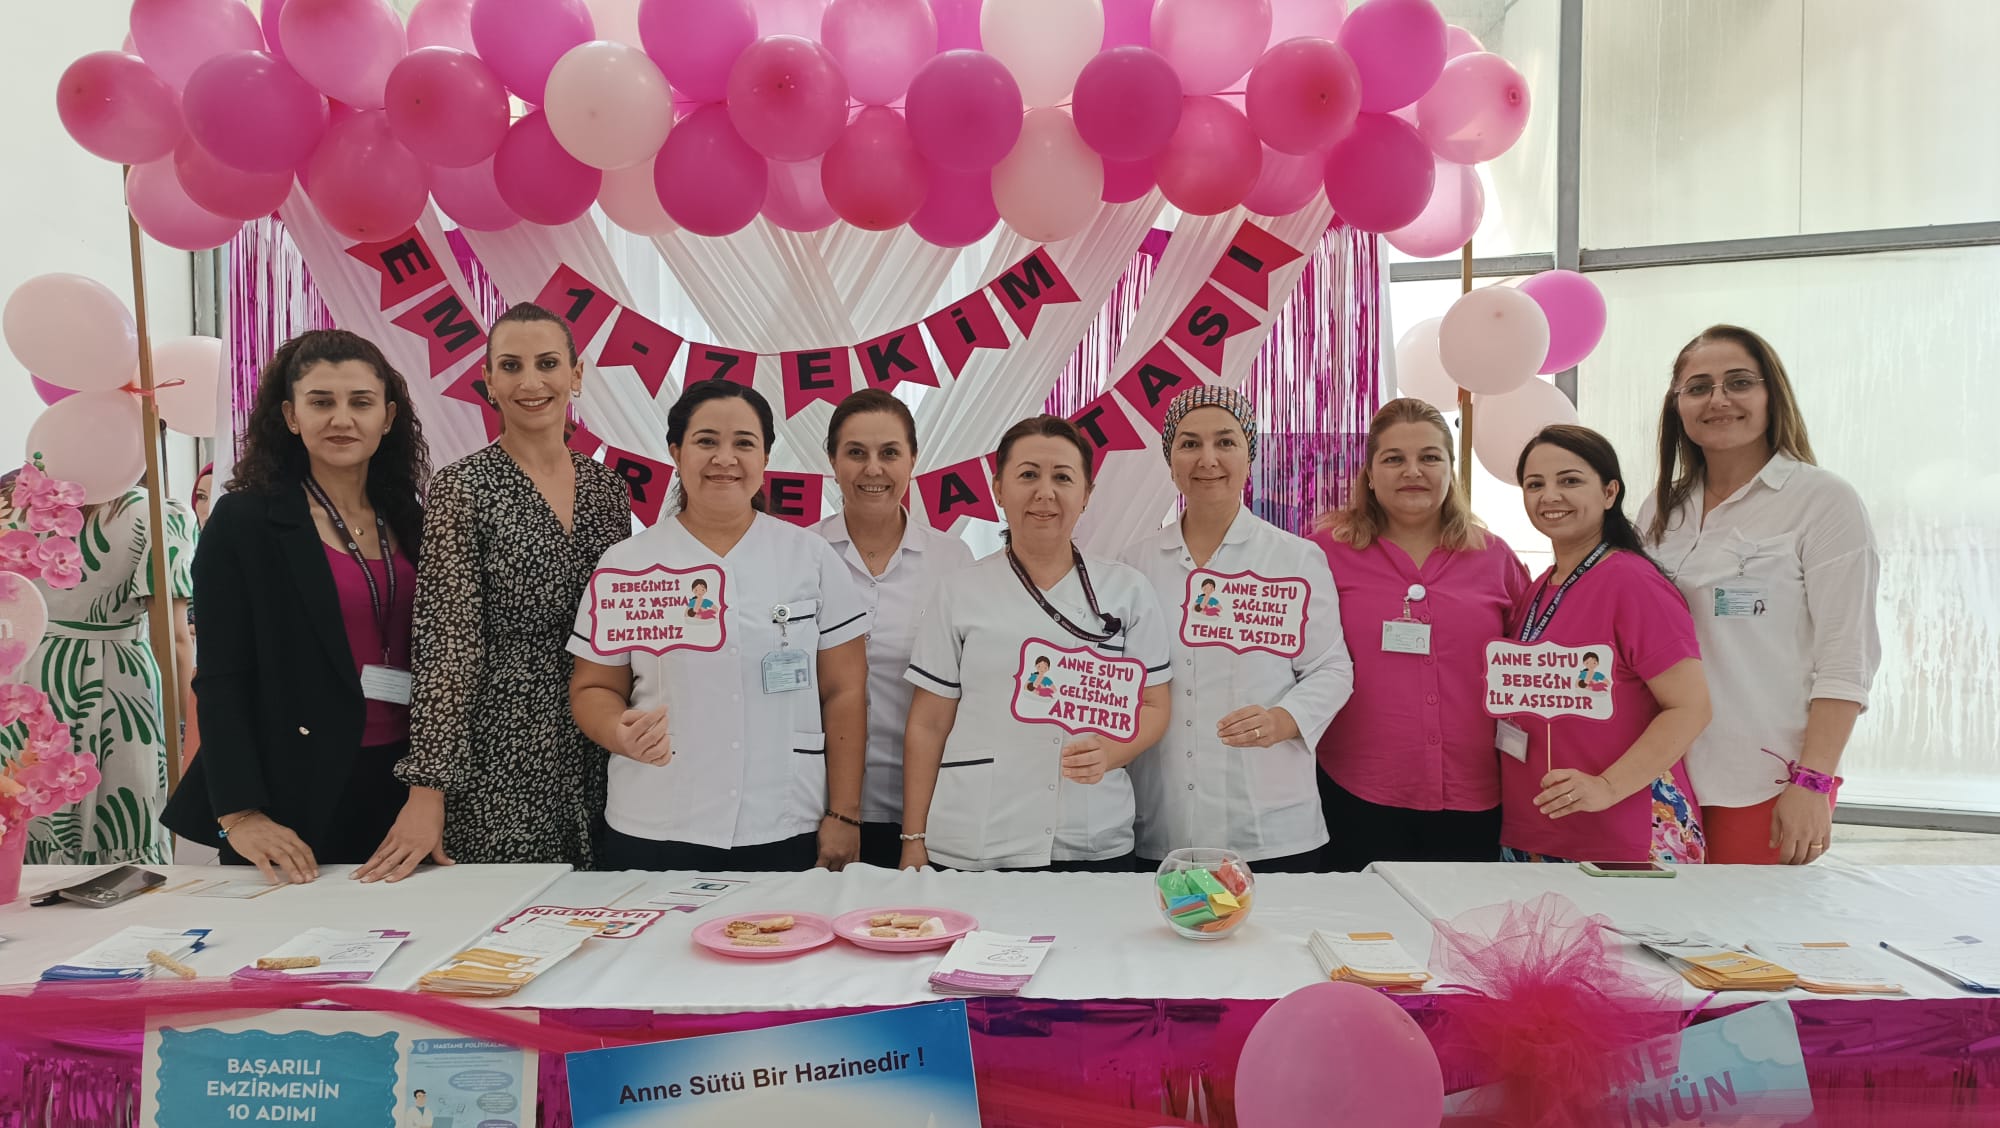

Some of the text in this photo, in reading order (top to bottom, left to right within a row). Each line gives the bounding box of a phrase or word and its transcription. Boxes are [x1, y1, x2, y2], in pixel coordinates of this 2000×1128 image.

[612, 579, 680, 593] BEBEĞİNİZİ
[1221, 581, 1257, 597] ANNE
[601, 596, 689, 609] EN AZ 2 YAŞINA
[1232, 598, 1288, 615] SAĞLIKLI
[626, 609, 664, 621] KADAR
[1233, 612, 1284, 628] YAŞAMIN
[607, 625, 683, 642] EMZİRİNİZ
[1191, 624, 1297, 648] TEMEL TAŞIDIR
[1057, 655, 1094, 674] ANNE
[1491, 652, 1533, 667] ANNE
[1080, 675, 1112, 691] ZEKA
[1502, 672, 1572, 690] BEBEĞİN
[1060, 684, 1129, 709] GELİŞİMİNİ
[1489, 689, 1593, 710] İLK AŞISIDIR
[1048, 699, 1131, 732] ARTIRIR
[529, 907, 651, 919] HAZİNEDİR
[227, 1058, 321, 1078] BAŞARILI
[619, 1047, 925, 1105] Anne Sütü Bir Hazinedir !
[207, 1077, 340, 1099] EMZİRMENİN
[227, 1104, 316, 1122] 10 ADIMI
